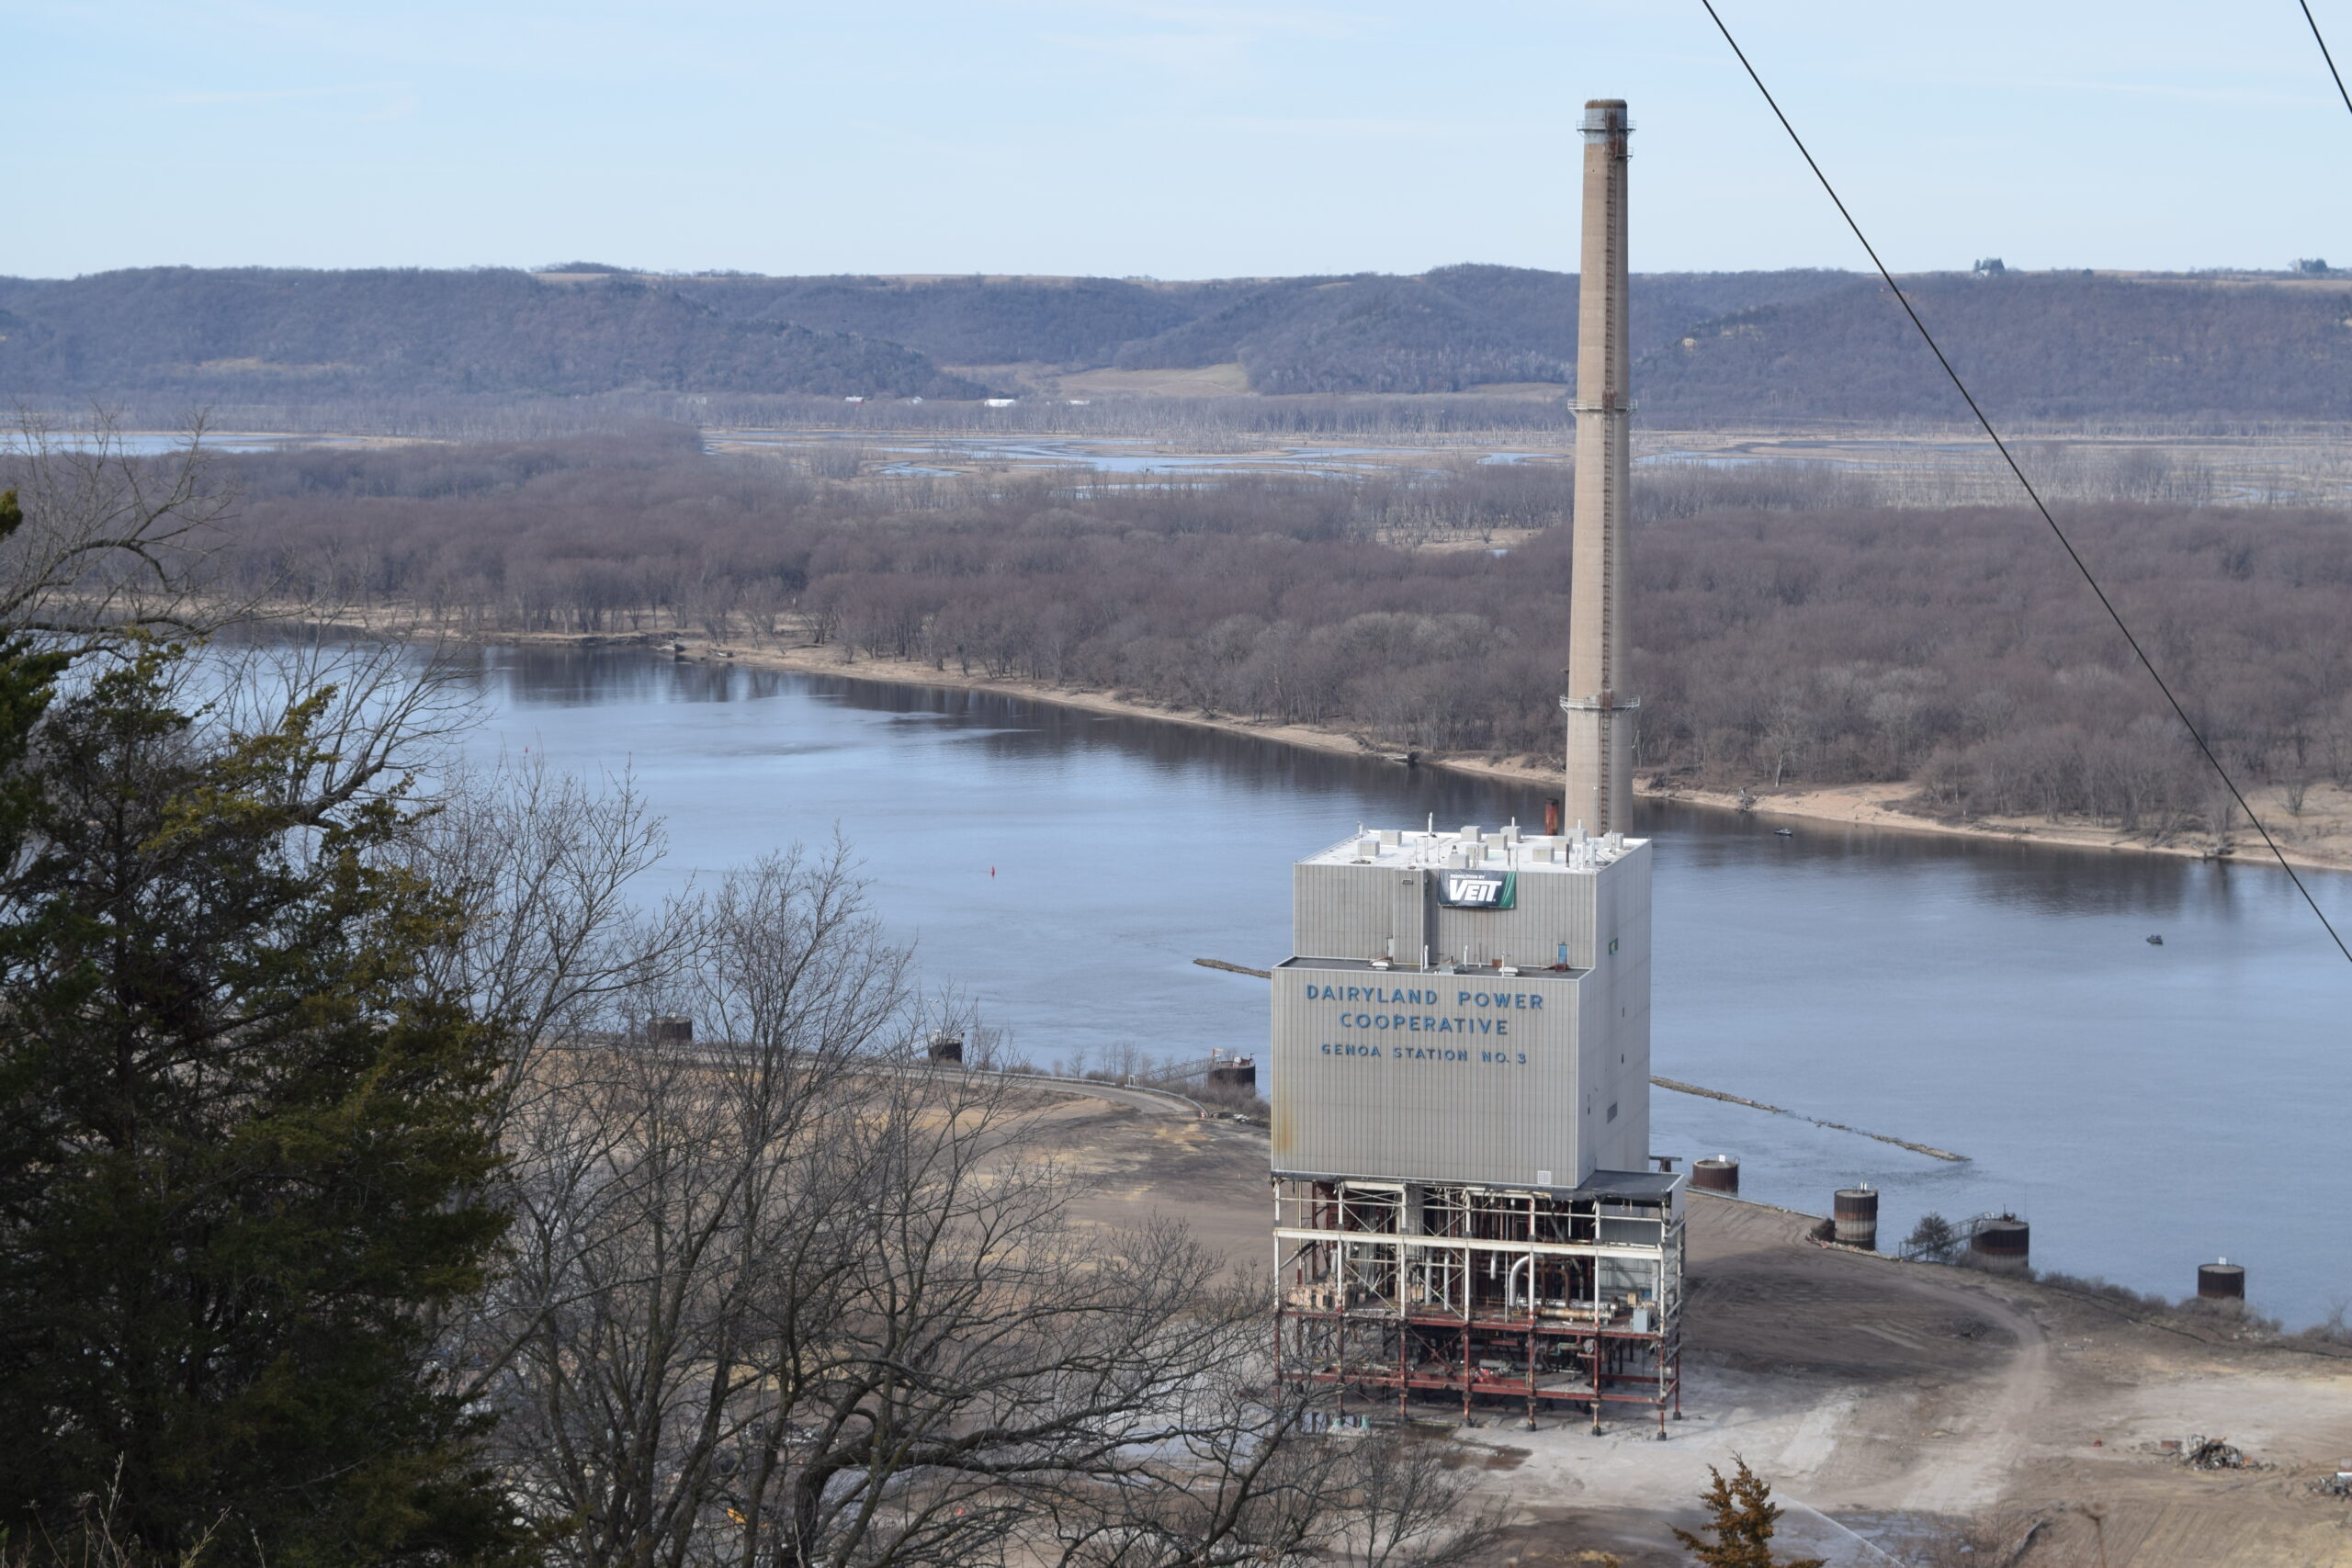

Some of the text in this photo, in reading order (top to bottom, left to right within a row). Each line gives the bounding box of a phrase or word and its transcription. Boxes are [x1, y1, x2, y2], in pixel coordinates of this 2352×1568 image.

[1449, 879, 1502, 902] VEIT
[1306, 984, 1544, 1010] DAIRYLAND POWER
[1339, 1011, 1509, 1035] COOPERATIVE
[1321, 1043, 1527, 1065] GENOA STATION NO. 3
